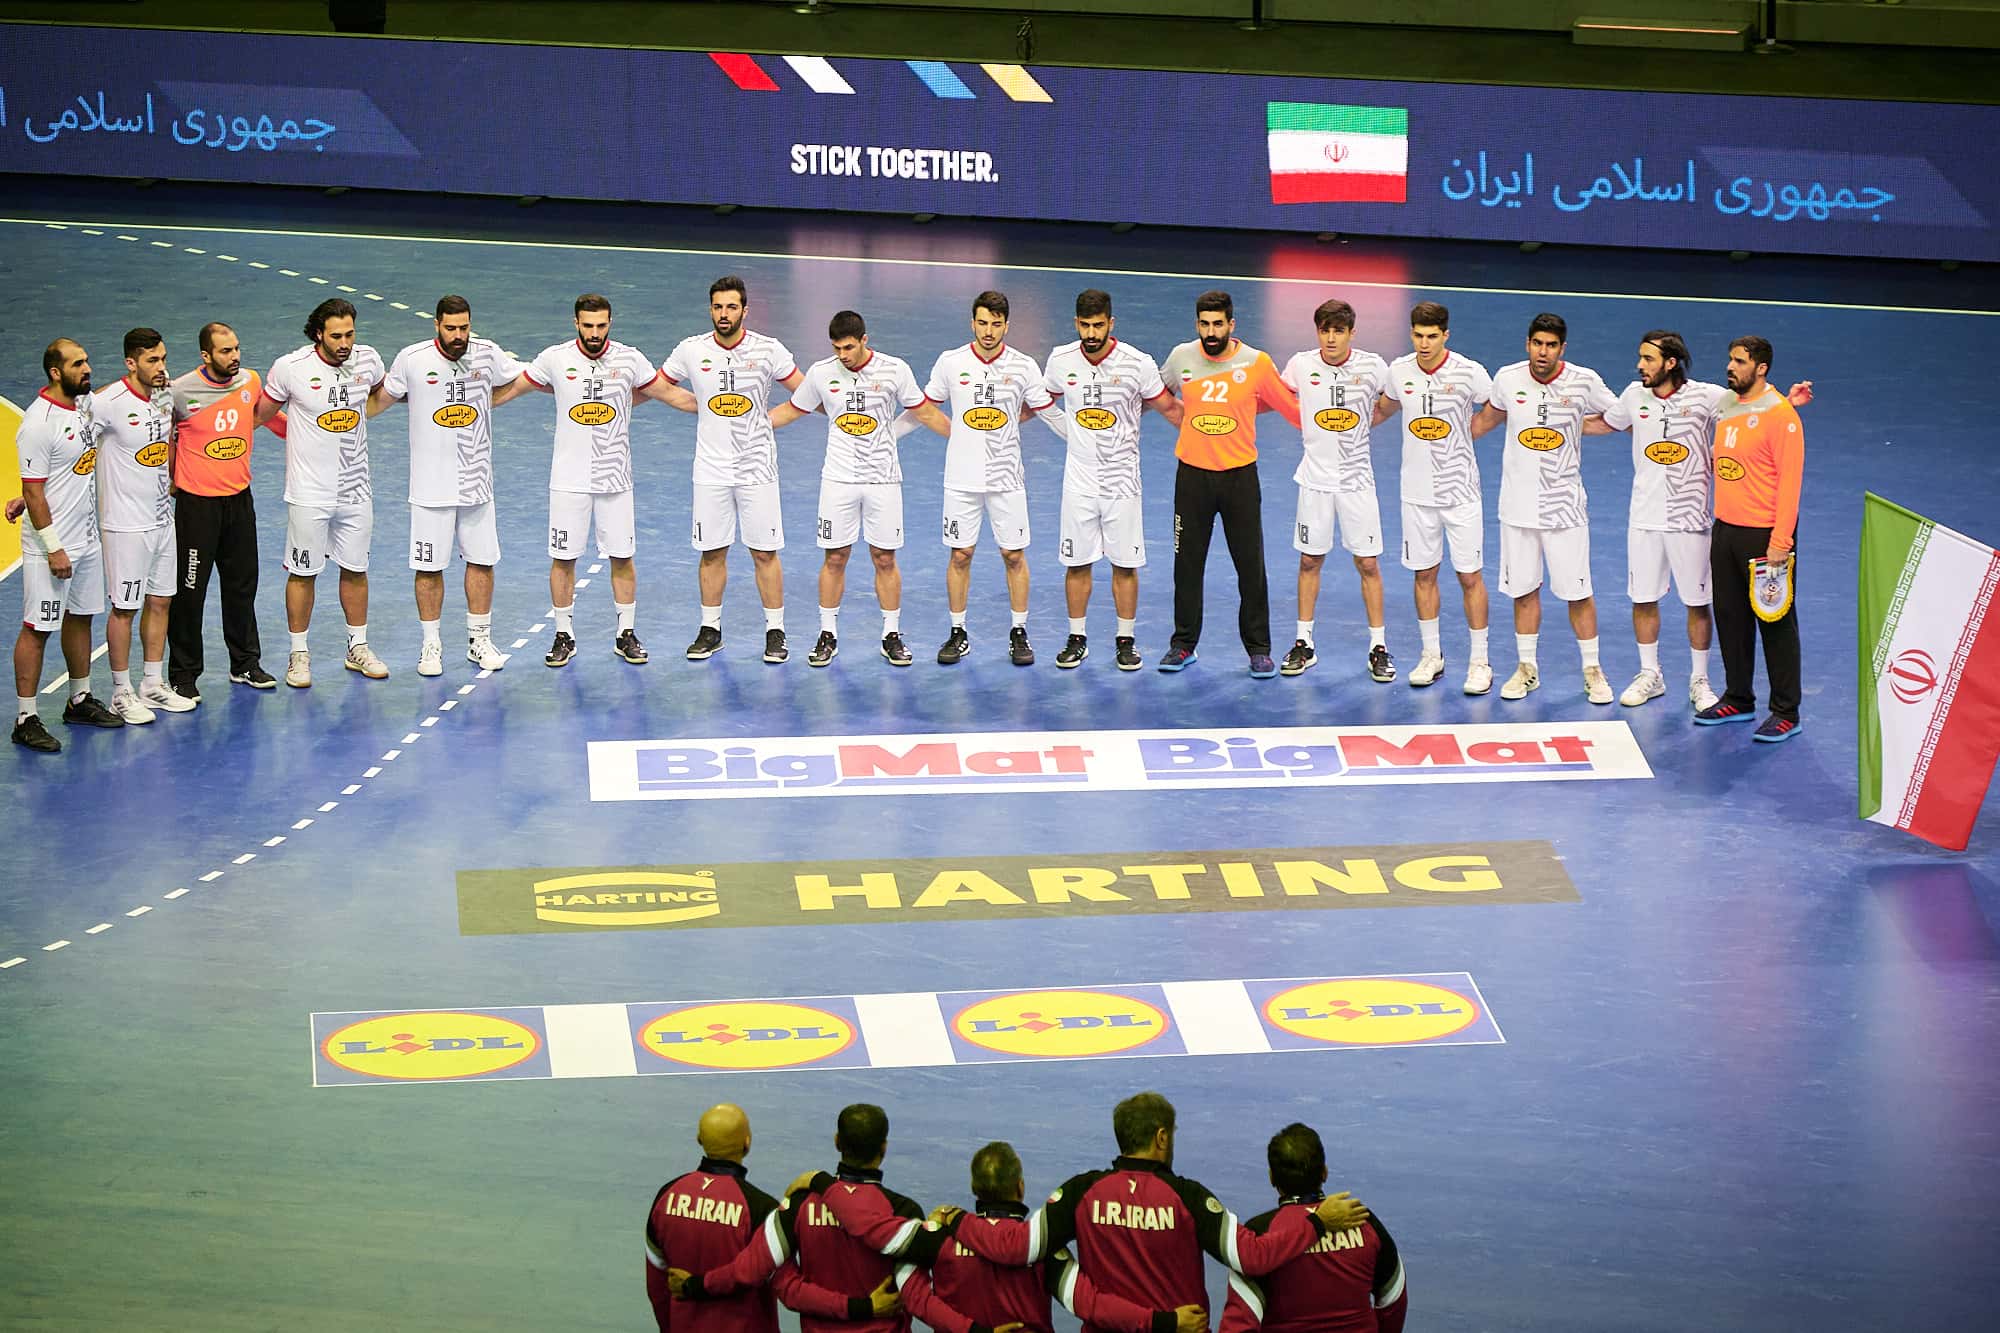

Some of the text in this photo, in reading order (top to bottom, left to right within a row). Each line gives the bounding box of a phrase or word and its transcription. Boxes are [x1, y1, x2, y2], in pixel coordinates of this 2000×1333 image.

[25, 91, 154, 143] اسلامی
[172, 109, 336, 152] جمهوری
[791, 143, 999, 182] STICK TOGETHER.
[1442, 150, 1895, 222] جمهوری اسلامی ایران
[583, 379, 603, 400] 32
[719, 371, 734, 391] 31
[1201, 380, 1229, 403] 22
[328, 385, 349, 407] 44
[445, 381, 465, 403] 33
[715, 396, 745, 409] ایرانسل
[974, 384, 994, 405] 24
[441, 407, 471, 420] ایرانسل
[577, 404, 608, 417] ایرانسل
[1421, 394, 1433, 415] 11
[215, 408, 238, 432] 69
[971, 410, 1001, 423] ایرانسل
[1322, 412, 1352, 423] ایرانسل
[1525, 431, 1557, 442] ایرانسل
[143, 446, 168, 460] یرانسل
[414, 541, 433, 562] 33
[184, 548, 202, 590] Kempa
[40, 600, 61, 621] 99
[636, 743, 1095, 790] BigMat
[1138, 734, 1594, 780] BigMat
[795, 855, 1503, 911] HARTING
[535, 890, 718, 907] HARTING
[665, 1192, 743, 1228] I.R.IRAN
[1092, 1200, 1175, 1231] I.R.IRAN
